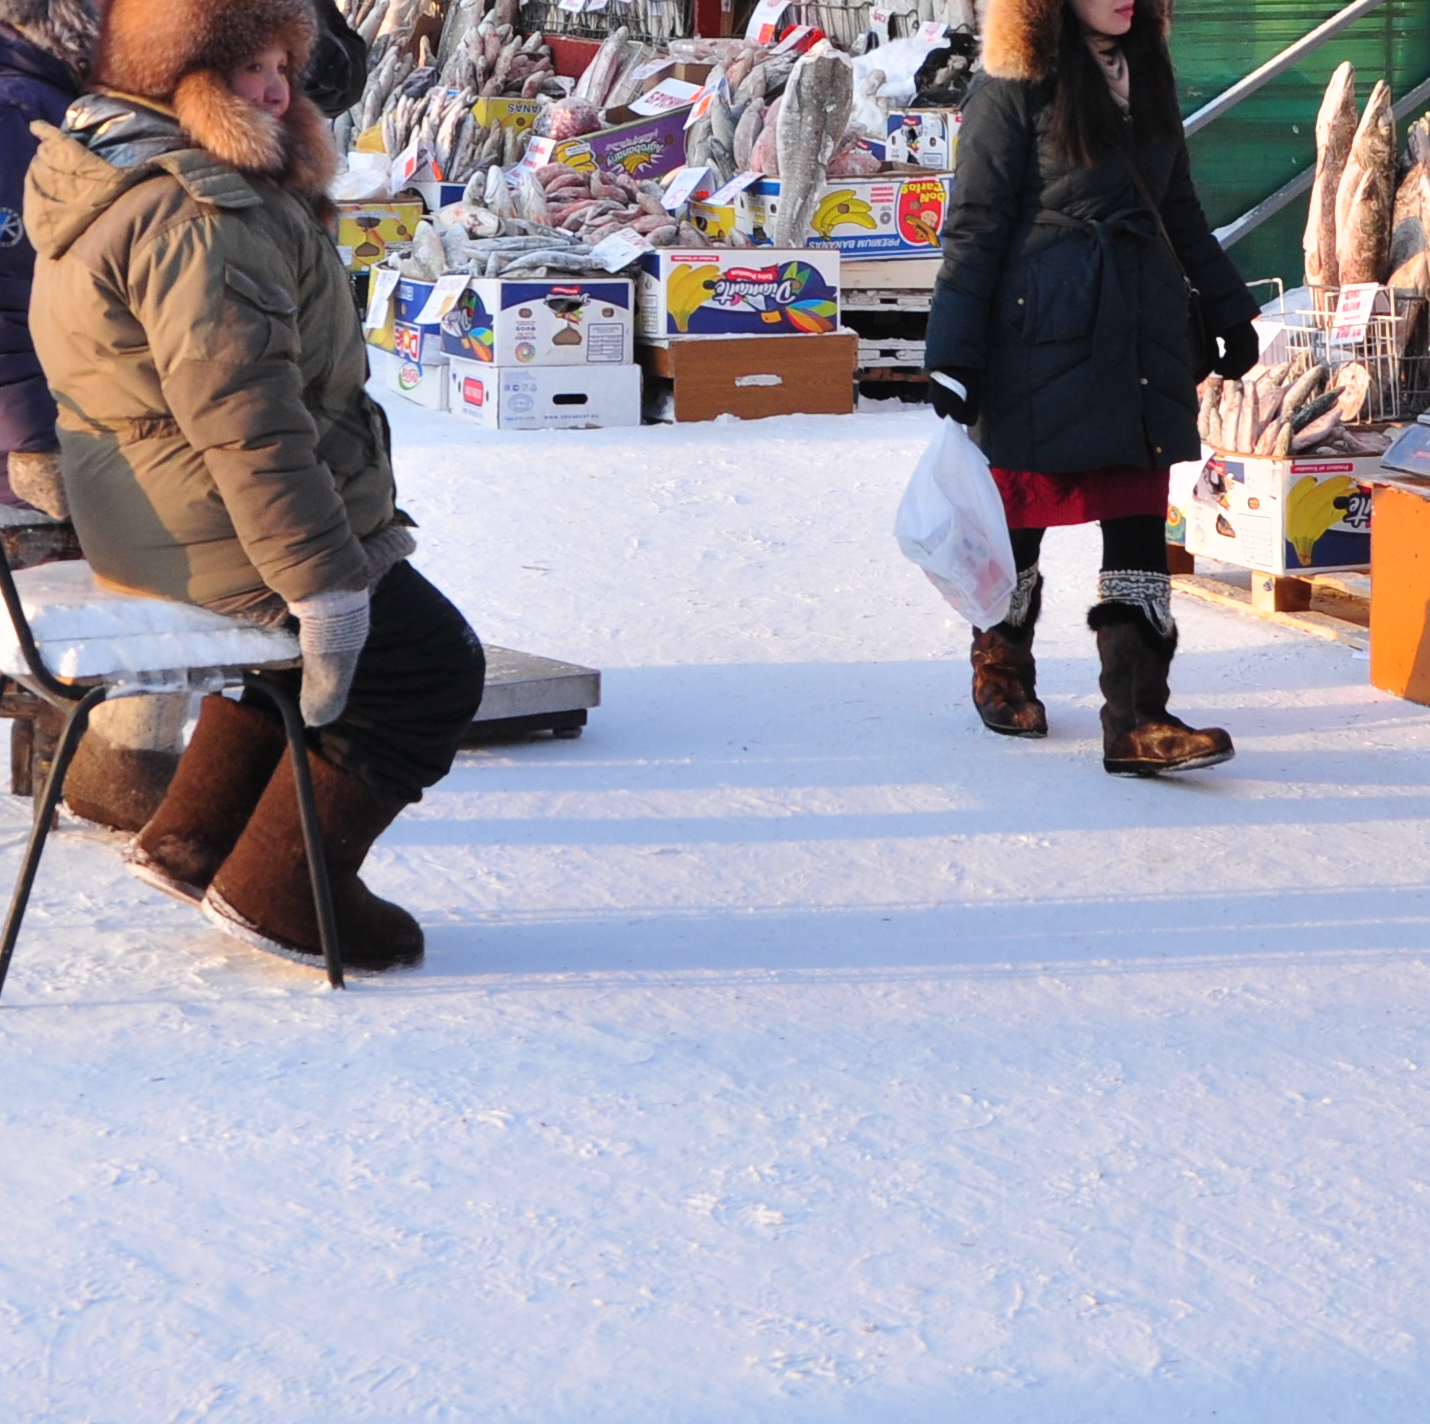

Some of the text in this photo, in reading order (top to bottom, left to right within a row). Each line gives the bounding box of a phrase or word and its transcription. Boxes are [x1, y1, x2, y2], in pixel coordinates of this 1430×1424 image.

[809, 237, 901, 249] PREMIUM BANANAS
[715, 280, 796, 305] Diamante
